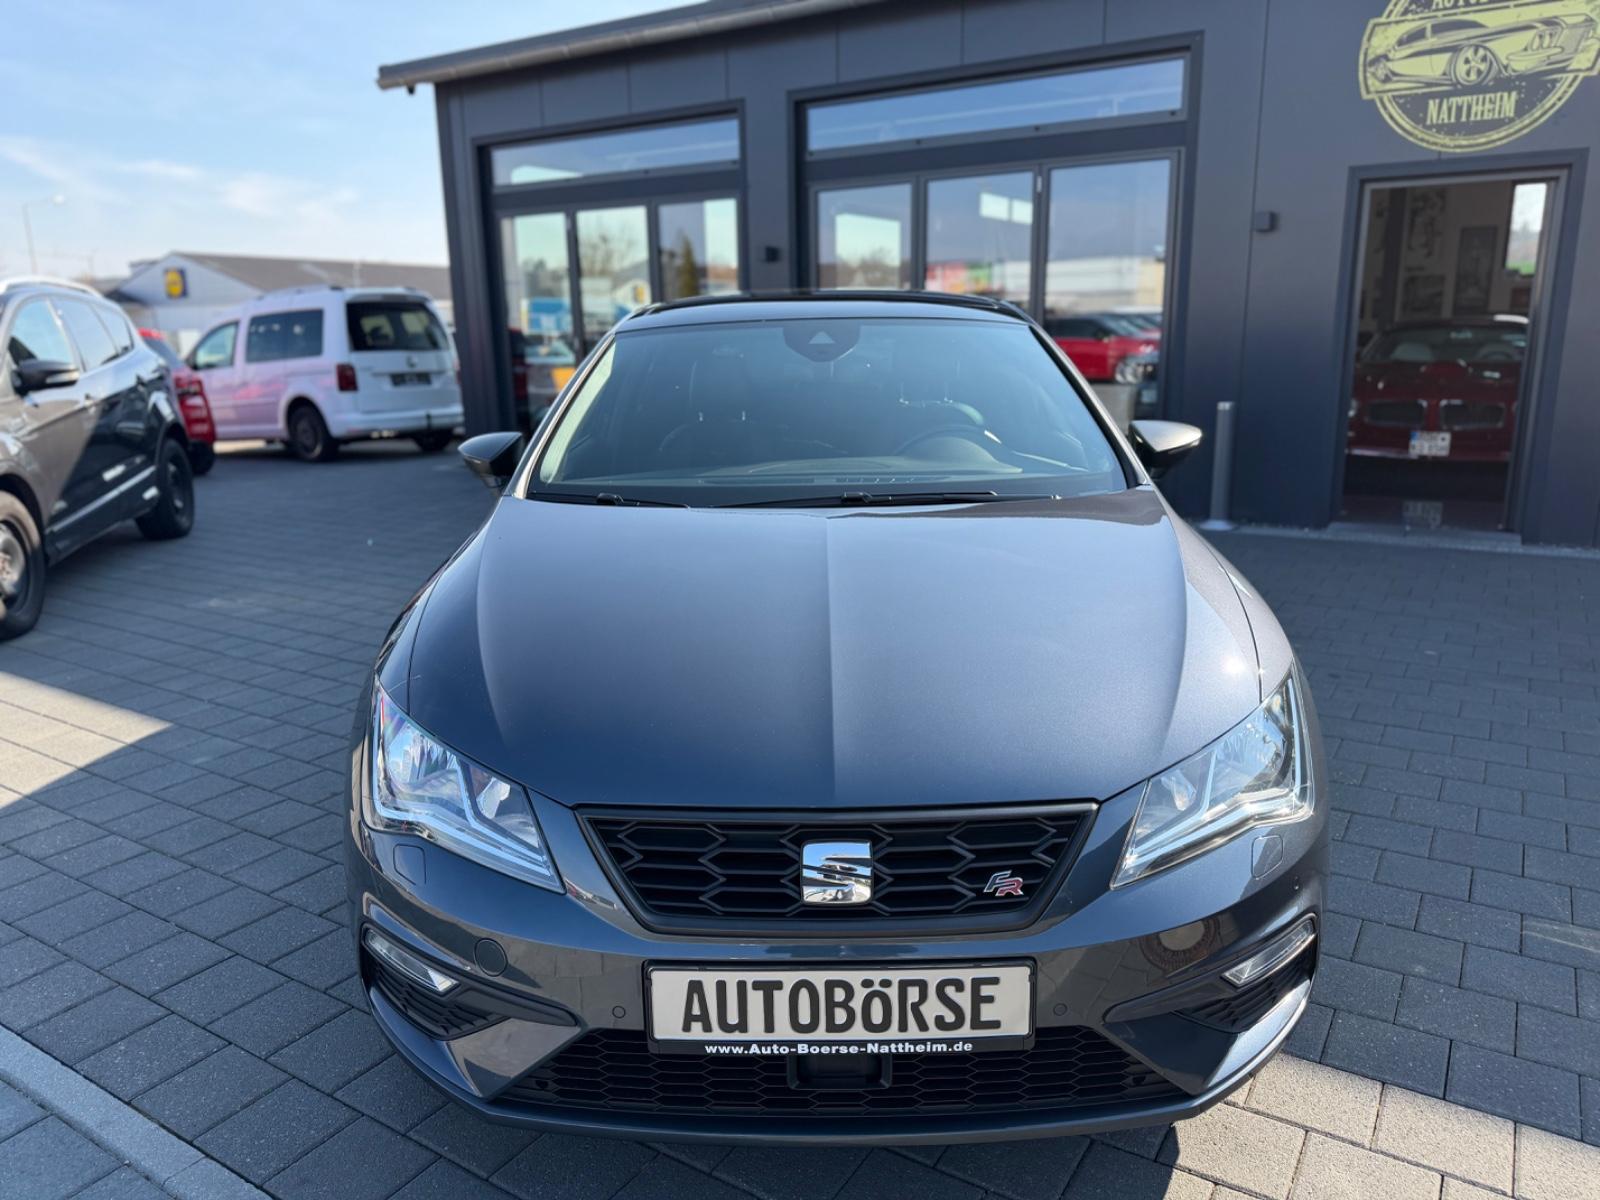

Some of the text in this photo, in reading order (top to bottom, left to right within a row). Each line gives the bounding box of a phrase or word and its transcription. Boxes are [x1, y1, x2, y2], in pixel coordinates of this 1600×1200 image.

[1426, 91, 1517, 125] NATTHEIM
[983, 870, 1024, 896] FR
[682, 977, 1001, 1033] AUTOBÖRSE
[704, 1041, 973, 1054] www.Auto-Boerse-Nattheim.de
